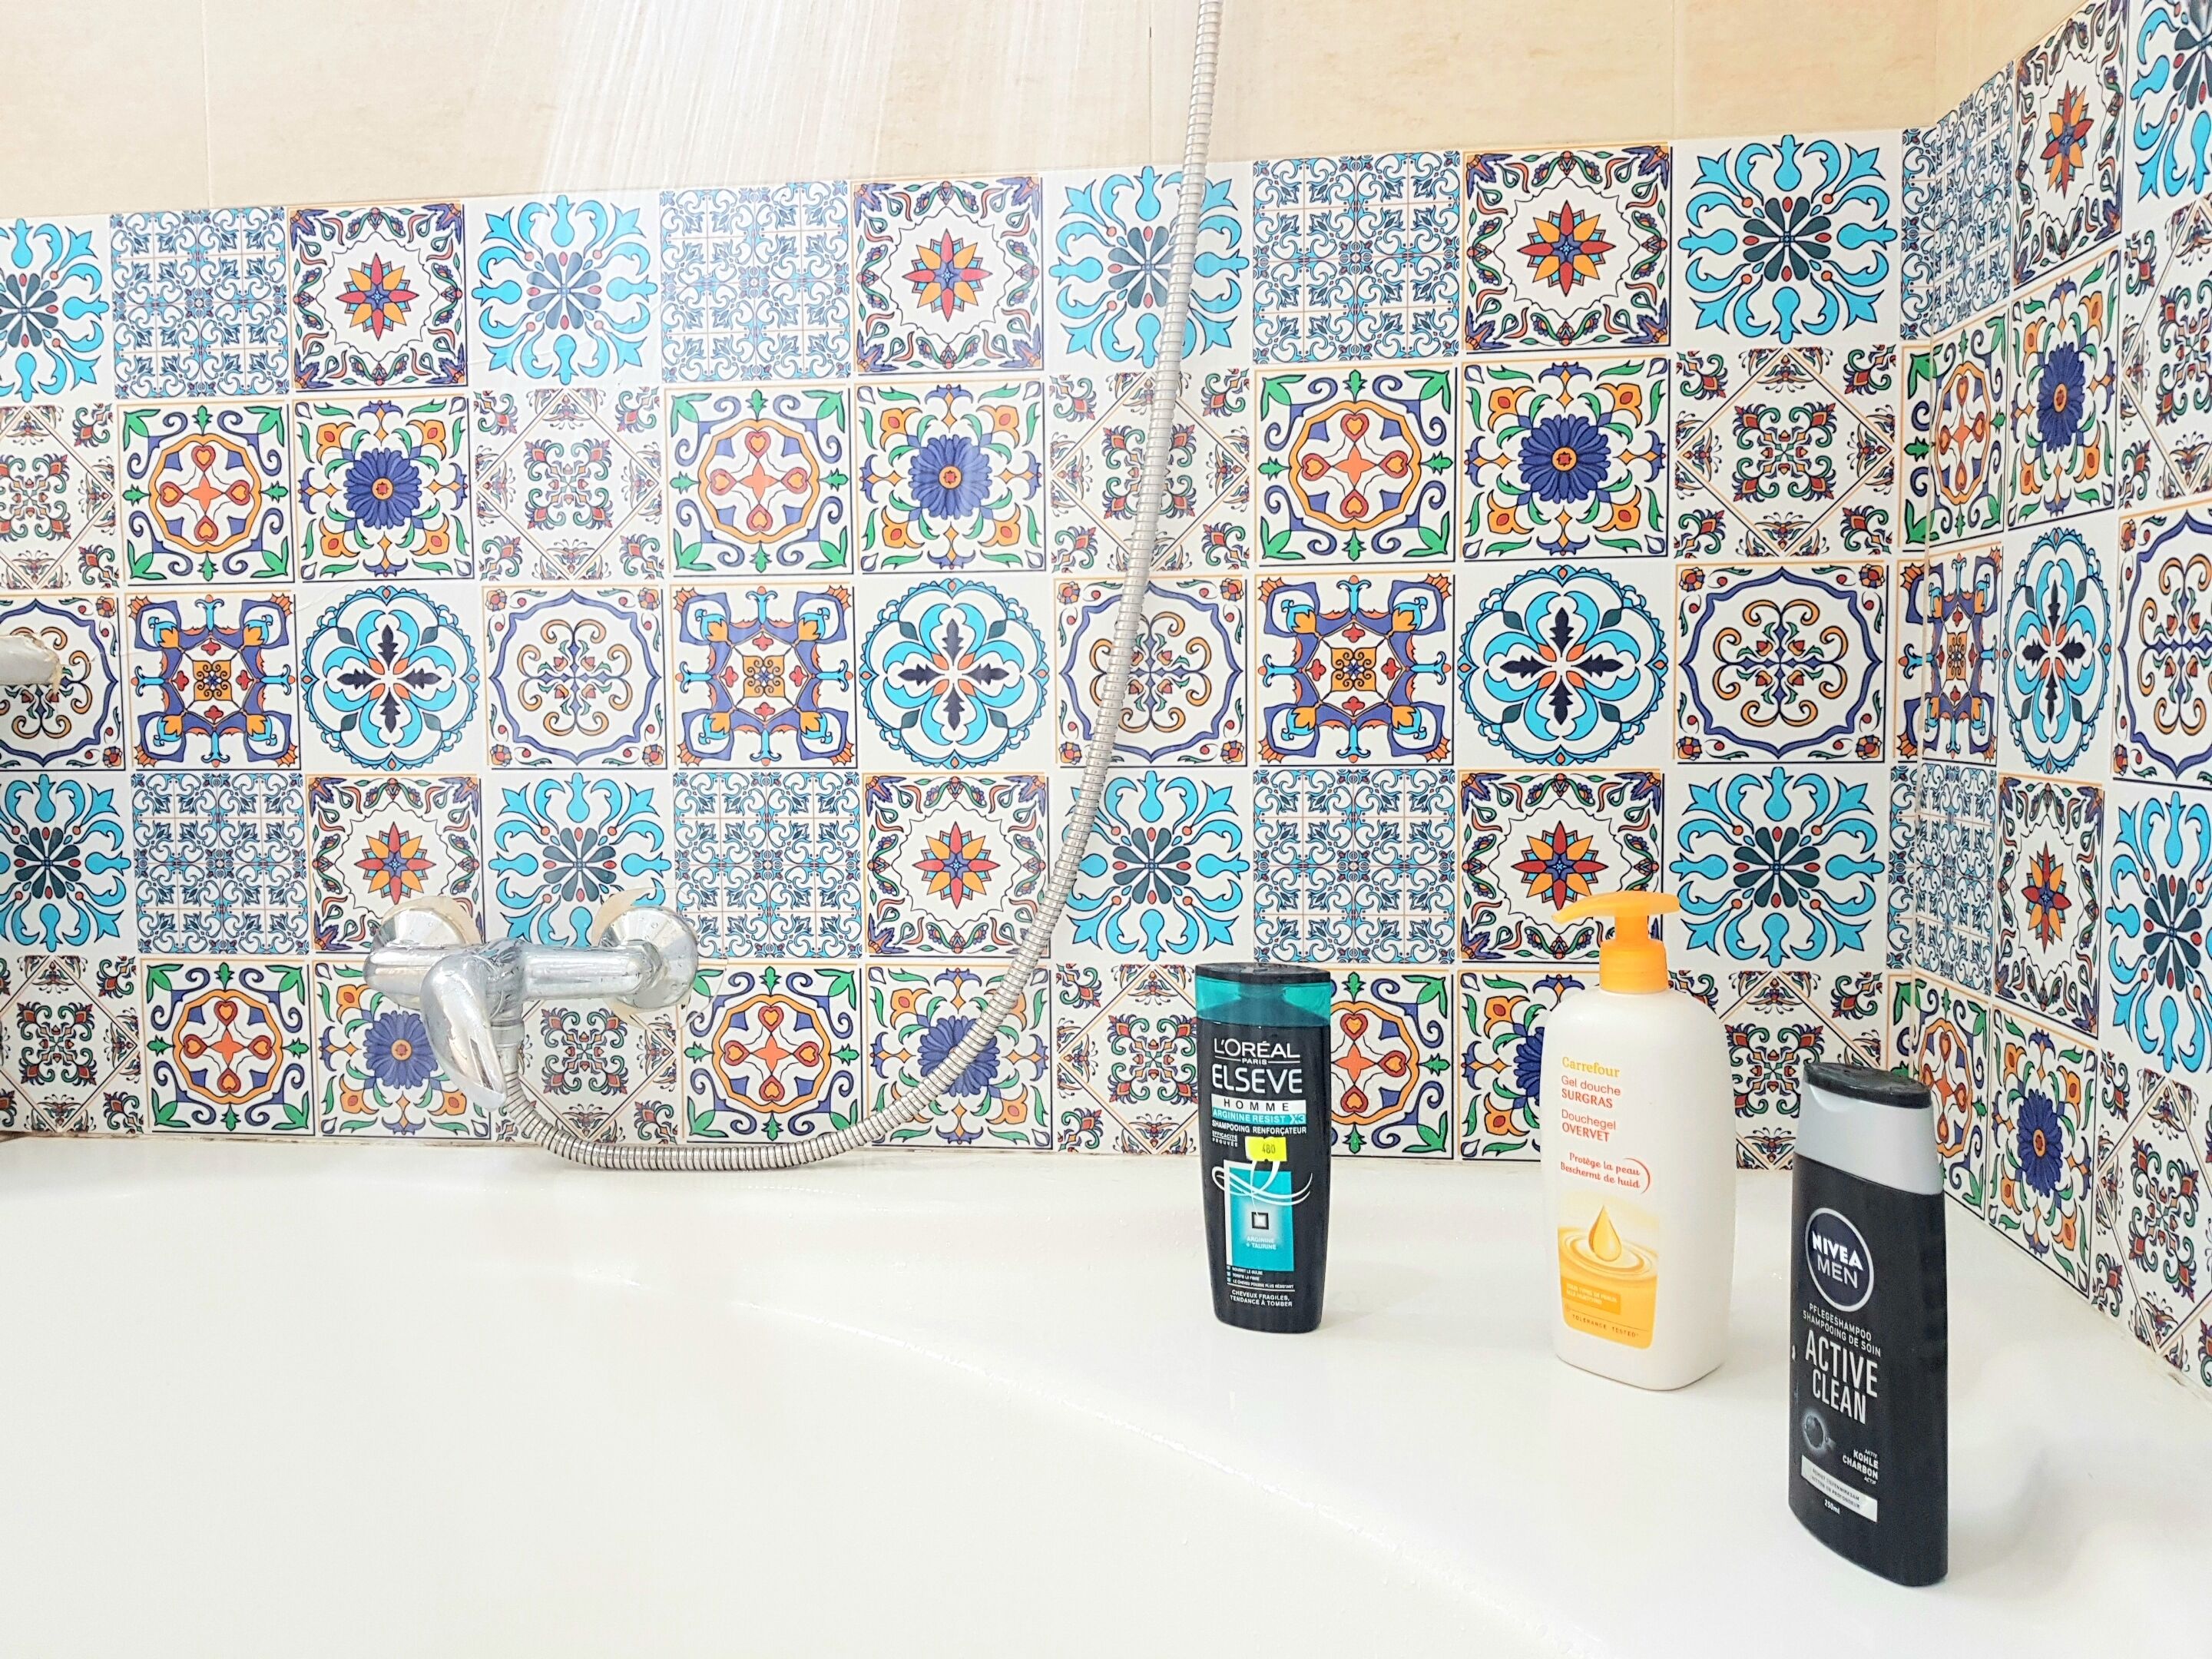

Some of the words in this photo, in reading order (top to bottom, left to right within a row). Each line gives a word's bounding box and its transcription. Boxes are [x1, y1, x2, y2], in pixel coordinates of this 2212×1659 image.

[1214, 1038, 1300, 1058] L'ORÉAL
[1562, 1056, 1620, 1077] Carrefour
[1212, 1064, 1303, 1094] ELSEVE
[1561, 1075, 1577, 1088] Gel
[1580, 1081, 1621, 1096] douche
[1224, 1098, 1289, 1111] HOMME
[1561, 1088, 1613, 1108] SURGRAS
[1212, 1108, 1250, 1122] ARGININE
[1252, 1114, 1286, 1124] RESIST
[1290, 1114, 1306, 1124] X3
[1561, 1109, 1616, 1131] Douchegel
[1212, 1120, 1250, 1133] SHAMPOOING
[1253, 1126, 1306, 1136] RENFORÇATEUR
[1562, 1122, 1610, 1142] OVERVET
[1569, 1152, 1601, 1169] Protège
[1604, 1161, 1613, 1171] la
[1616, 1165, 1640, 1176] peau
[1560, 1162, 1601, 1181] Beschermt
[1604, 1174, 1615, 1184] de
[1618, 1177, 1641, 1188] huid
[1812, 1230, 1863, 1271] NIVEA
[1817, 1253, 1858, 1289] MEN
[1230, 1295, 1260, 1305] TENDANCE
[1232, 1290, 1257, 1298] CHEVEUX
[1572, 1314, 1607, 1330] TOLERANCE
[1809, 1303, 1872, 1342] PFLEGESHAMPOO
[1803, 1310, 1846, 1340] SHAMPOOING
[1848, 1336, 1859, 1347] DE
[1861, 1340, 1881, 1357] SOIN
[1805, 1330, 1878, 1398] ACTIVE
[1813, 1369, 1866, 1425] CLEAN
[1842, 1455, 1878, 1480] CHARBON
[1853, 1449, 1879, 1469] KOHLE
